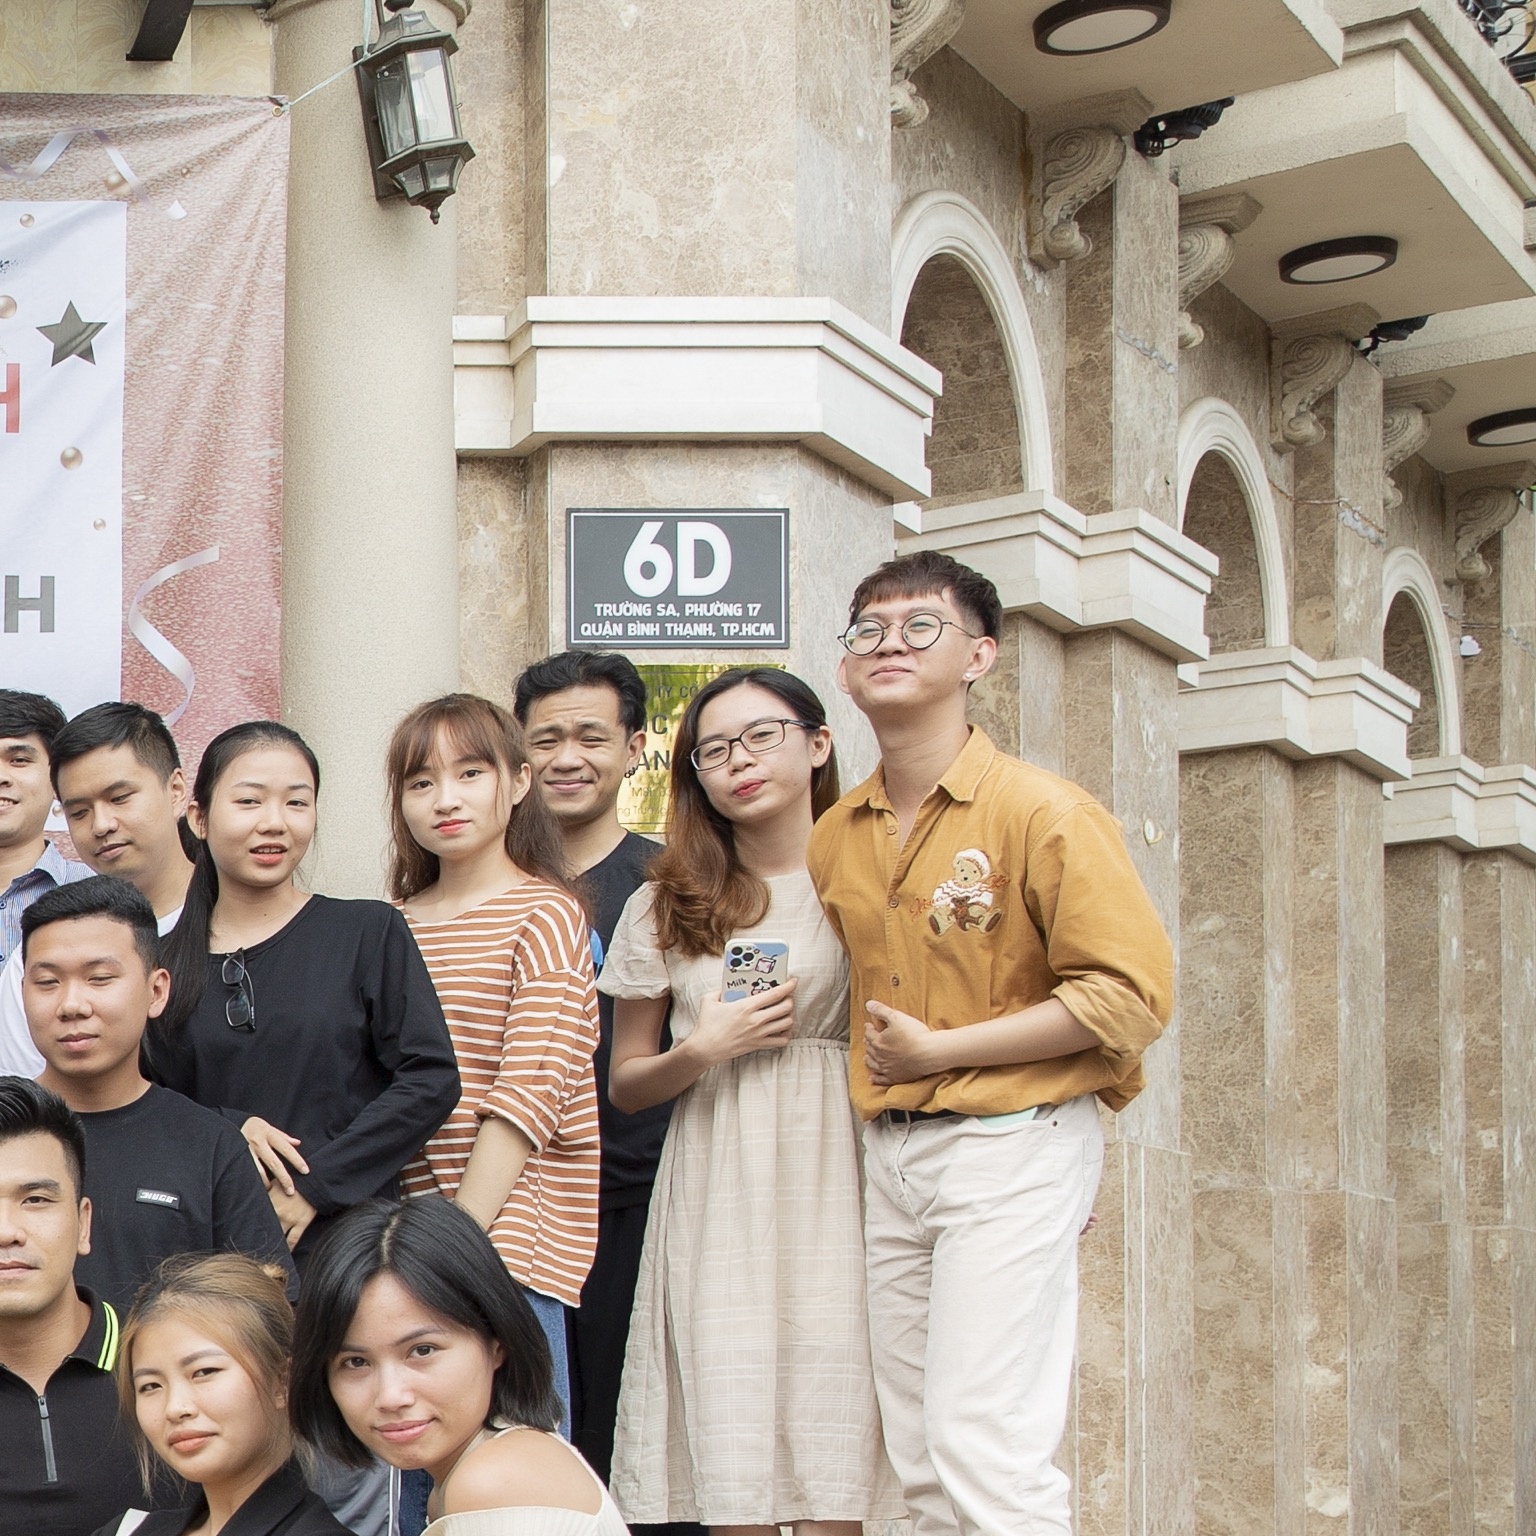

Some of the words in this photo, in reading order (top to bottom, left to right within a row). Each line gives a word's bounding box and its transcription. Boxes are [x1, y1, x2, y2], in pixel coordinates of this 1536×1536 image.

[623, 521, 732, 598] 6D
[594, 601, 651, 616] TRƯỜNG
[657, 603, 680, 617] SA,
[685, 600, 742, 616] PHƯỜNG
[747, 603, 761, 616] 17
[581, 621, 622, 638] QUẬN
[628, 621, 659, 636] BÌNH
[665, 622, 716, 638] THẠNH,
[721, 622, 775, 636] TP.HCM
[727, 978, 747, 988] Milk
